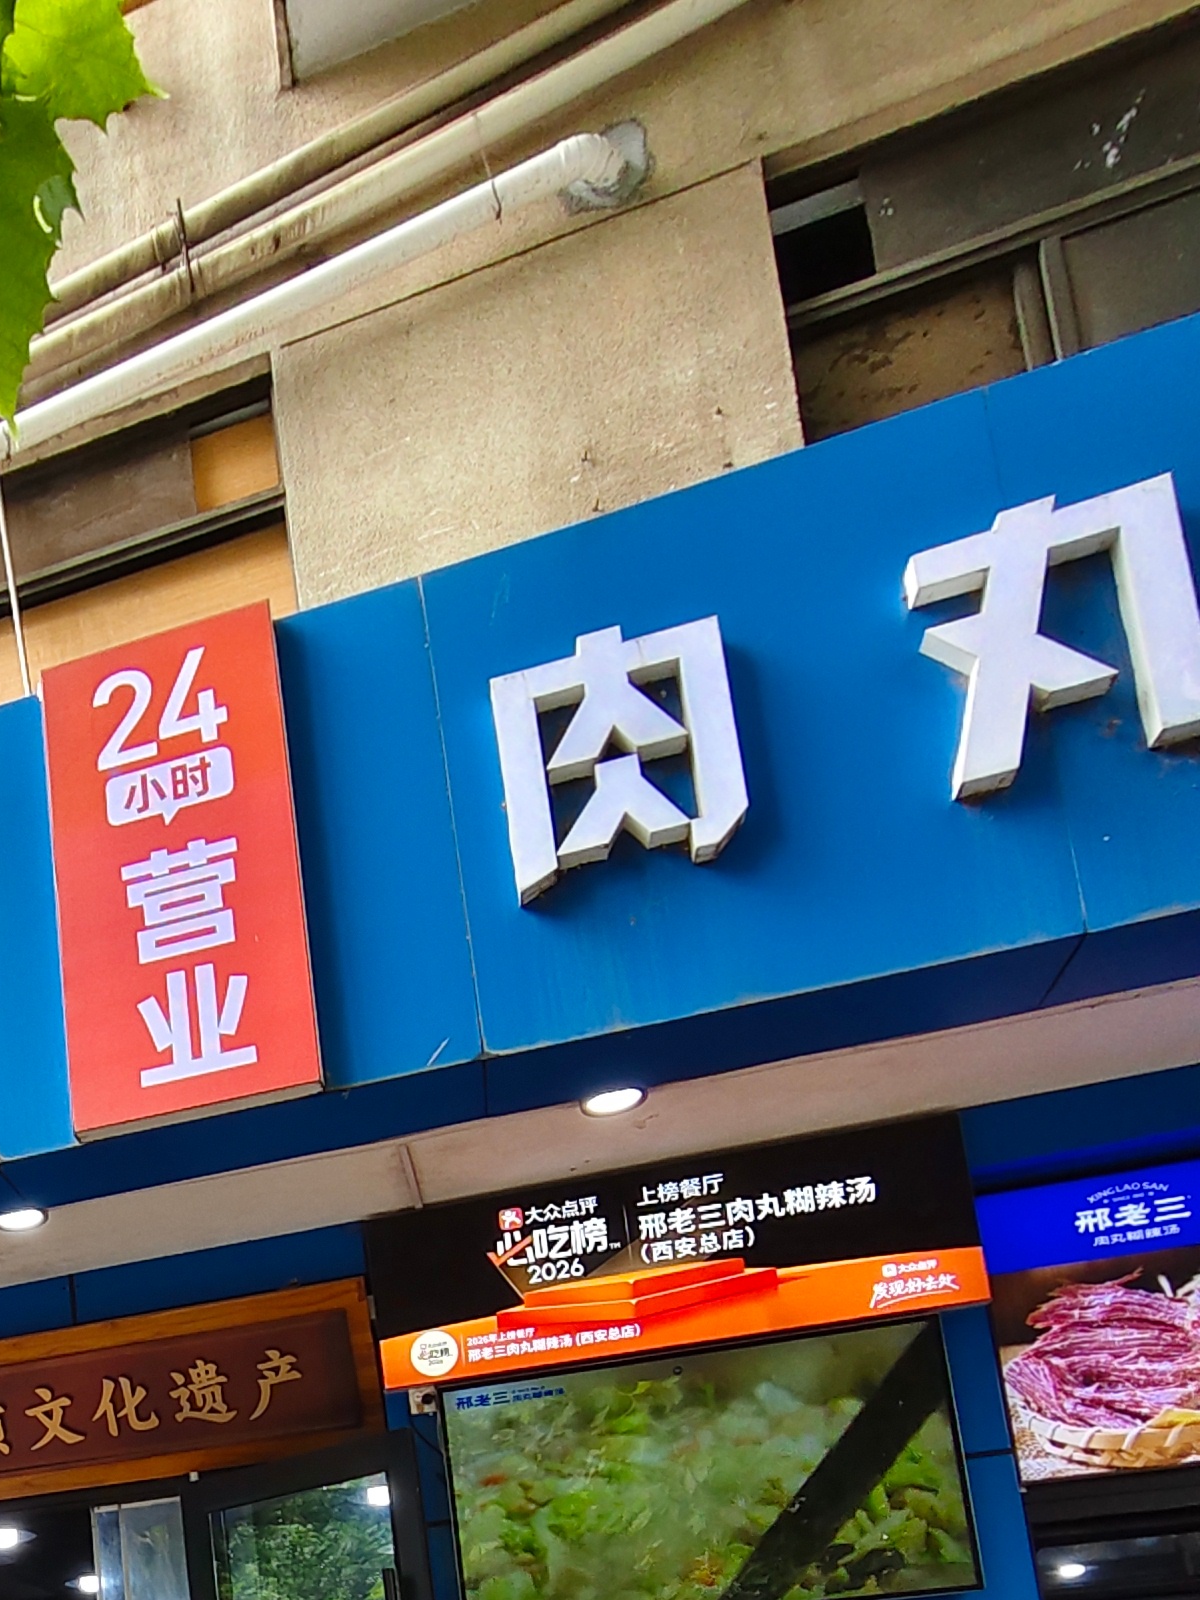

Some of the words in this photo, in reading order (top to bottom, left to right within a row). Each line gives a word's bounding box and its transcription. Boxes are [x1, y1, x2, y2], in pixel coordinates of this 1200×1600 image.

[92, 646, 228, 771] 24
[490, 471, 1200, 907] 肉丸
[124, 754, 214, 816] 小时
[121, 837, 258, 1088] 营业
[524, 1196, 598, 1226] 大众点评
[636, 1173, 724, 1206] 上榜餐厅
[638, 1175, 877, 1240] 邢老三肉丸糊辣汤
[1074, 1195, 1192, 1233] 邢老三
[526, 1259, 585, 1285] 2026
